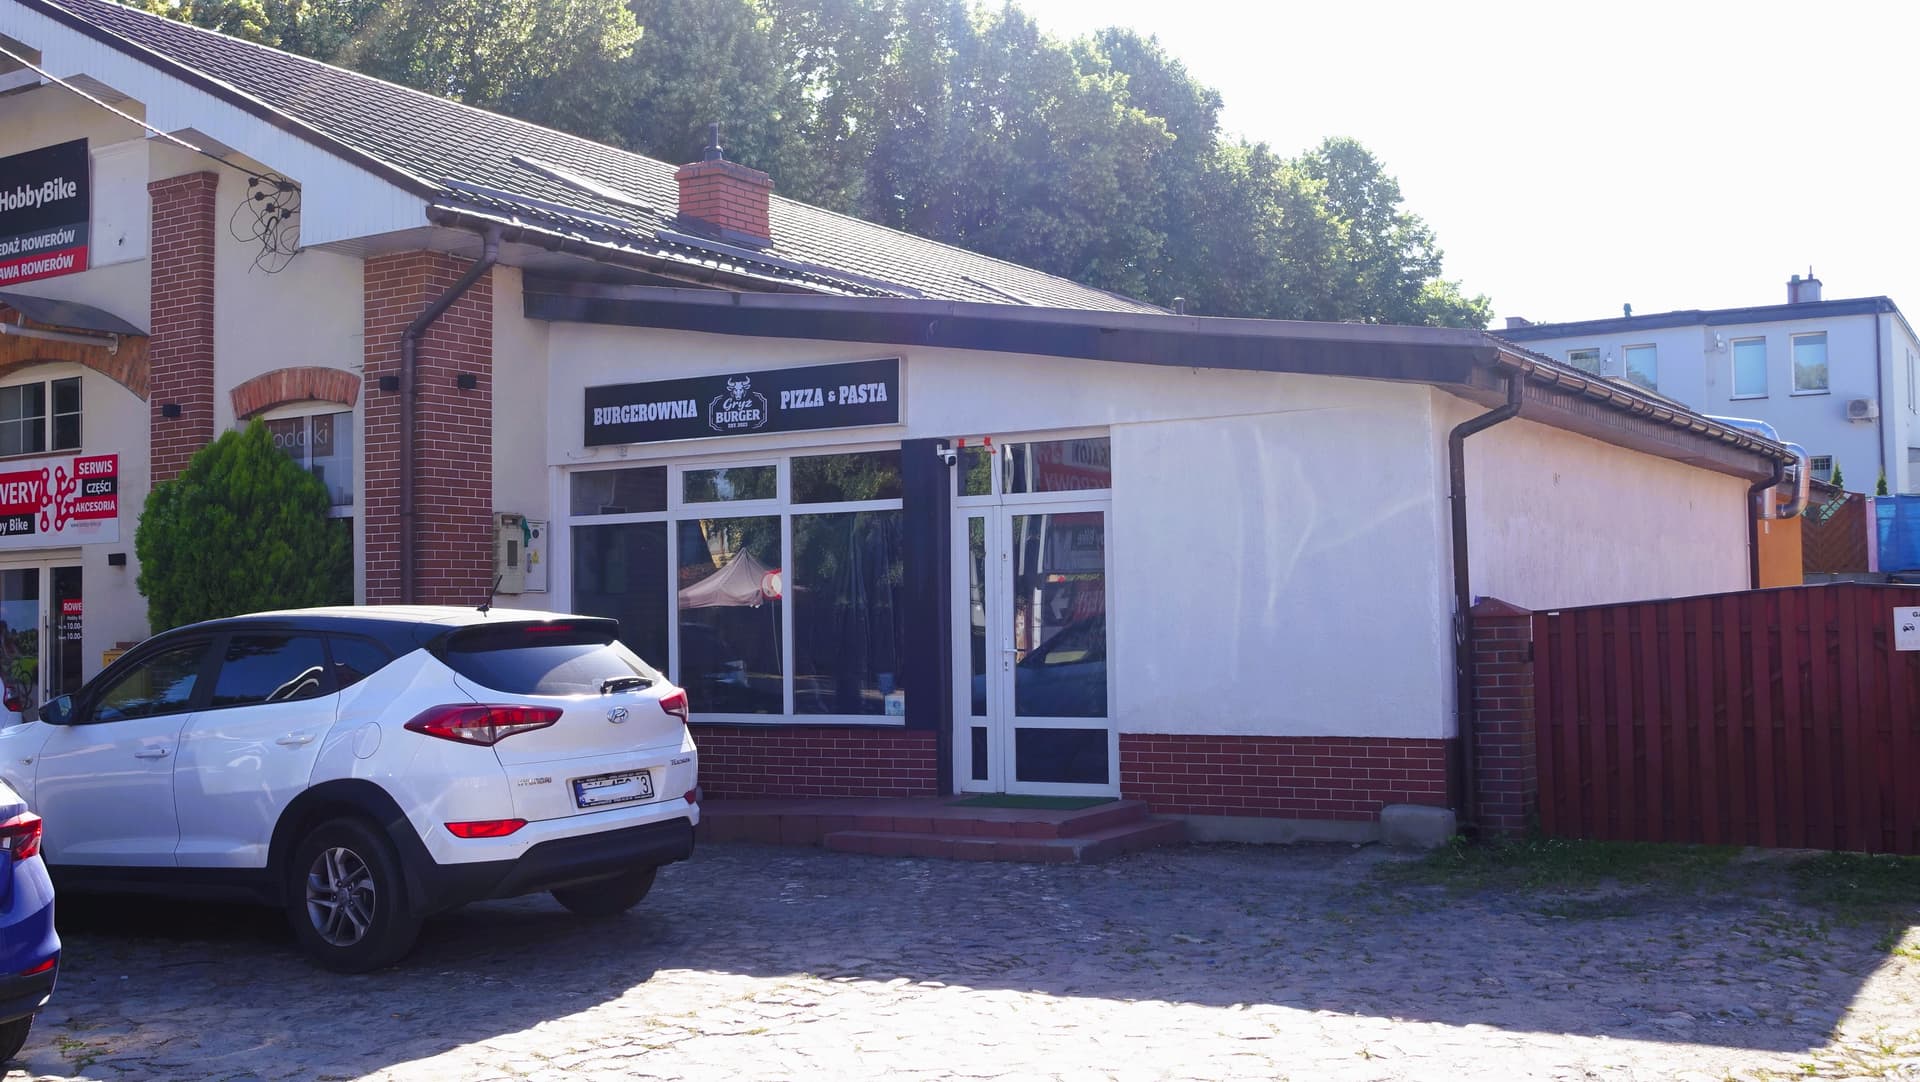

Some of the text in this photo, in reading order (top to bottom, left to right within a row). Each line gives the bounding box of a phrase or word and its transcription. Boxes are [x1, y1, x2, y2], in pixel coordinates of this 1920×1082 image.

[0, 177, 77, 211] HobbyBike
[21, 229, 75, 252] ROWERÓW
[21, 254, 74, 276] ROWERÓW
[780, 382, 888, 410] PIZZA & PASTA
[593, 399, 698, 426] BURGEROWNIA
[715, 409, 761, 424] BURGER
[78, 460, 113, 475] SERWIS
[86, 479, 112, 495] CZĘŚCI
[75, 500, 116, 513] AKCESORIA
[9, 517, 29, 532] Bike
